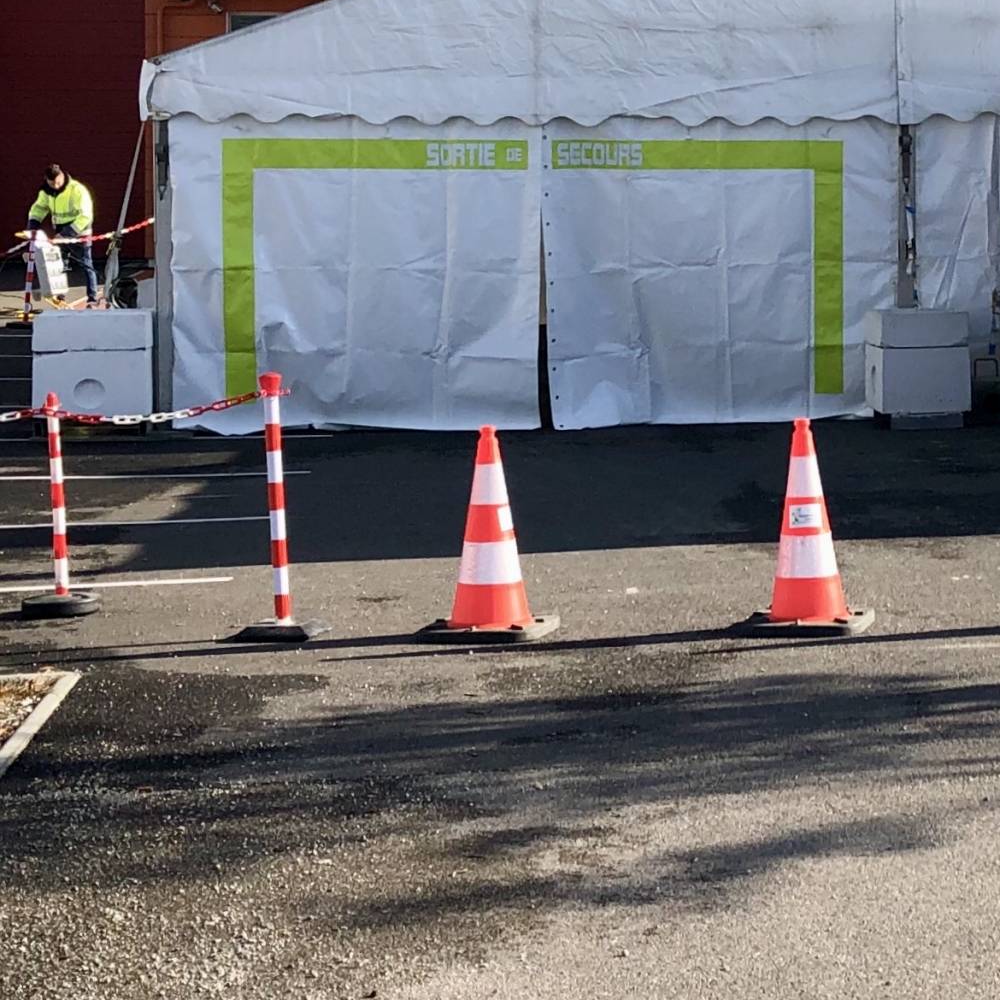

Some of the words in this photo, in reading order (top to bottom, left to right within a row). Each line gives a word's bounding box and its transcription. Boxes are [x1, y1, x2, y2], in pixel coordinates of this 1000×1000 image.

[426, 143, 496, 167] SORTIE
[506, 148, 522, 162] DE
[557, 143, 643, 167] SECOURS
